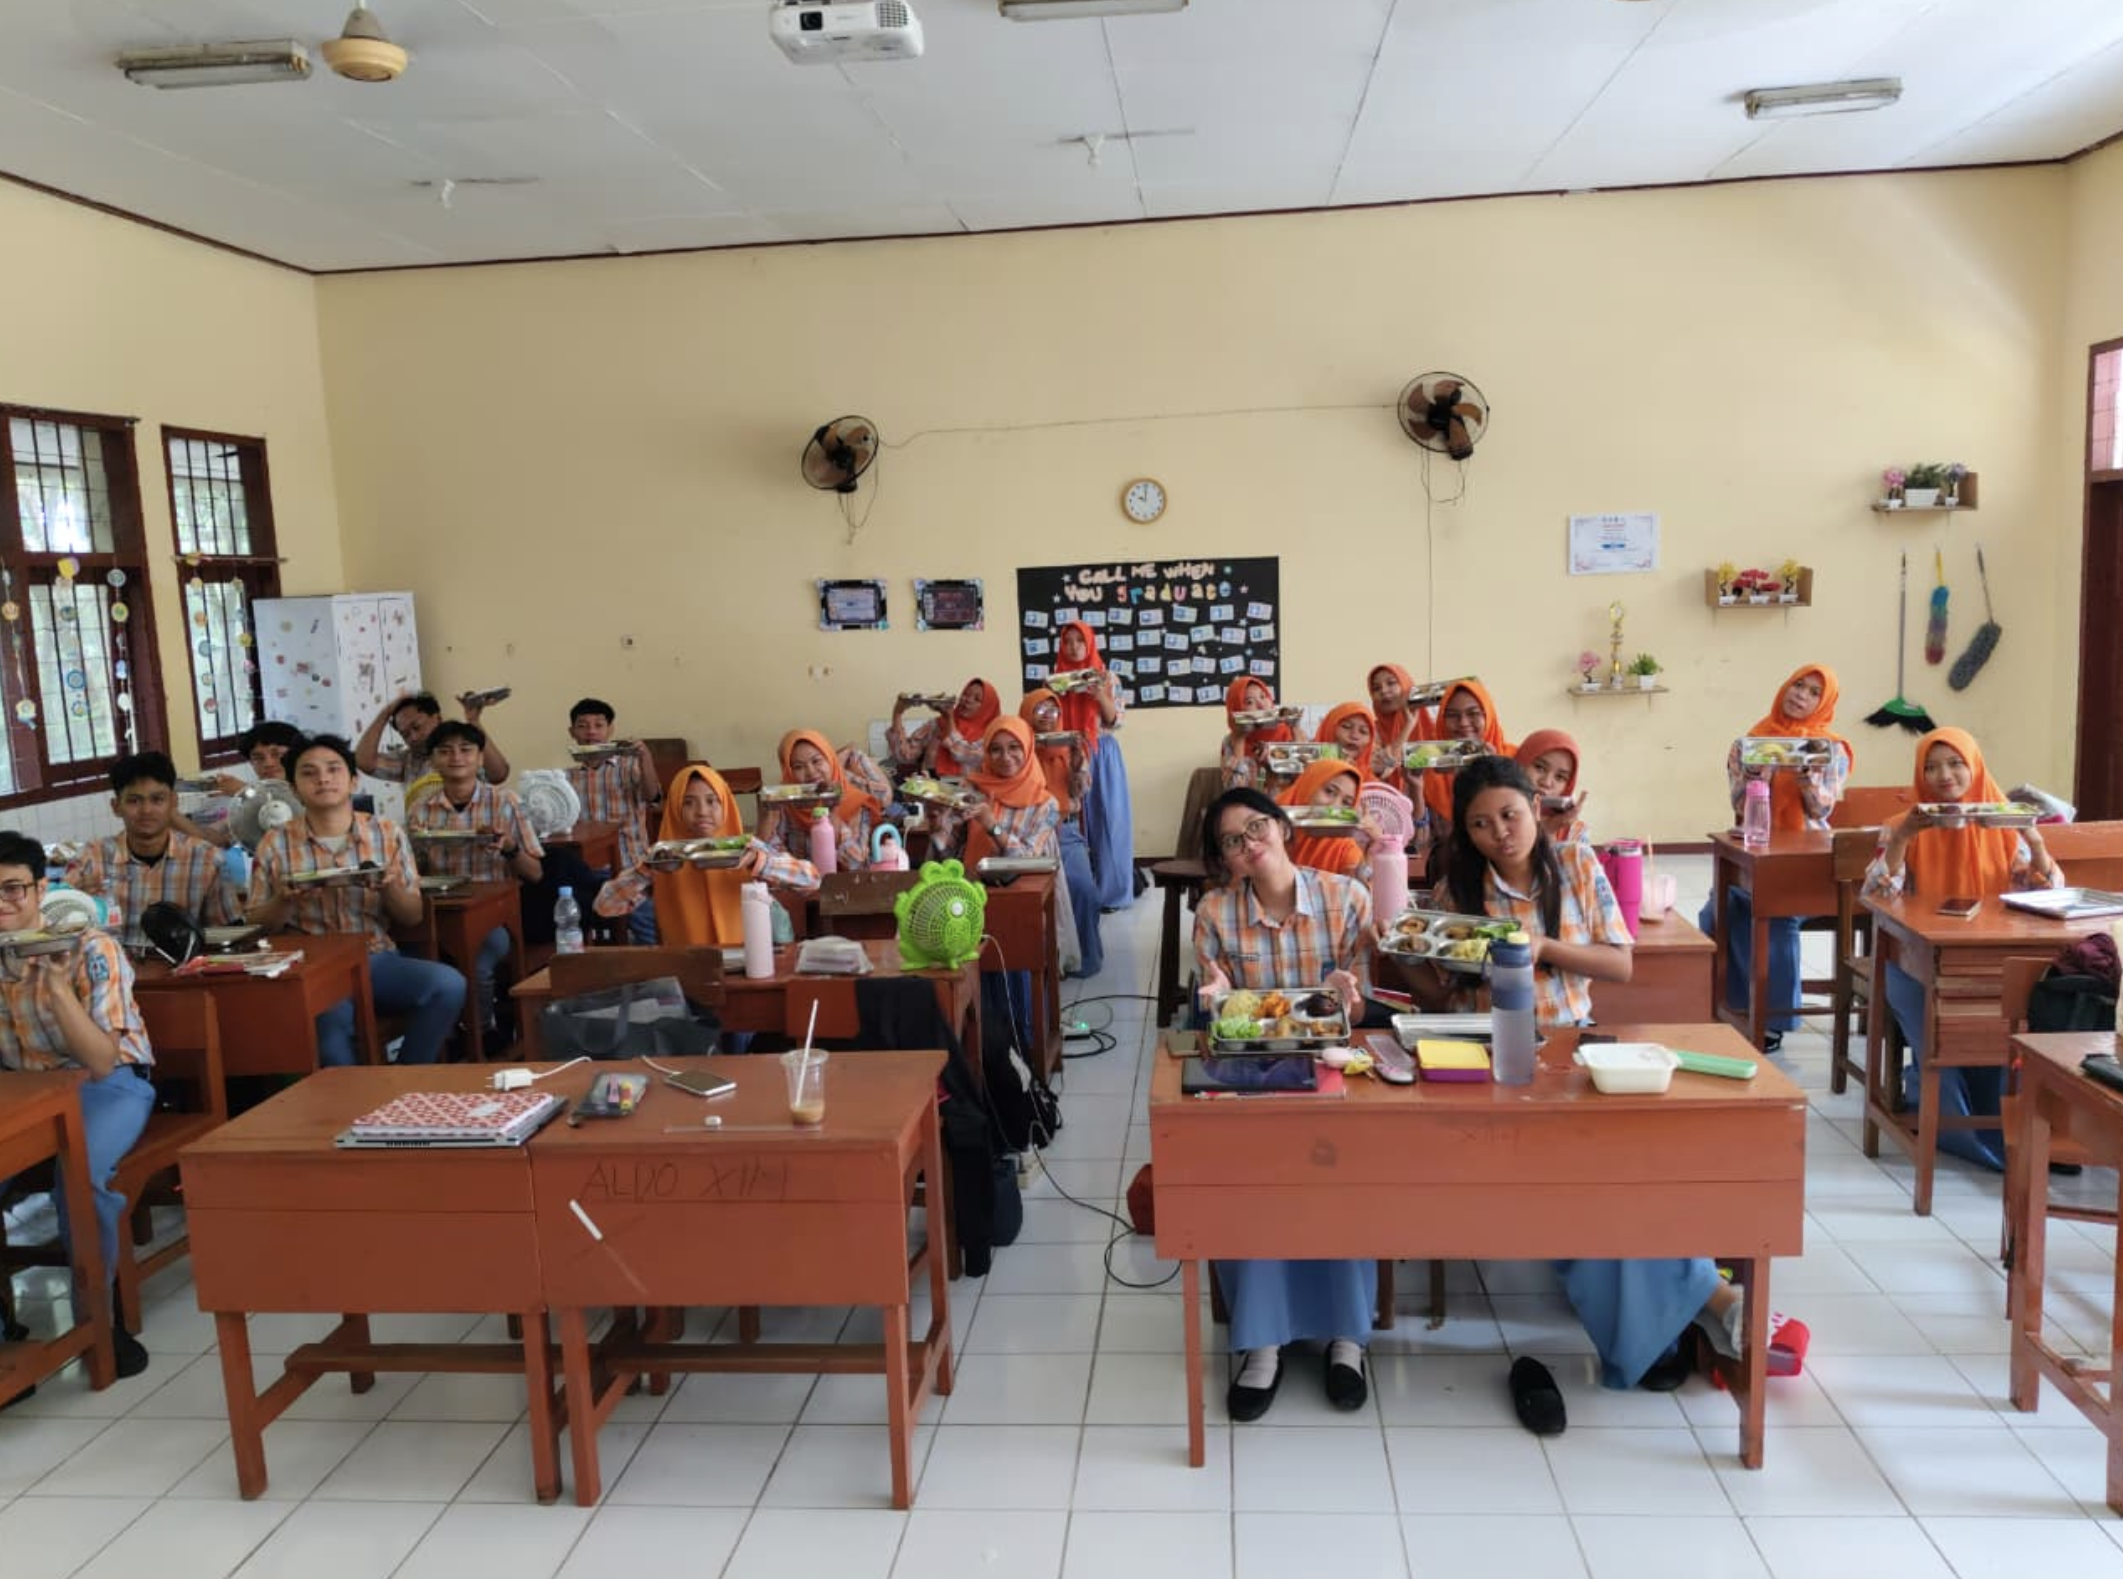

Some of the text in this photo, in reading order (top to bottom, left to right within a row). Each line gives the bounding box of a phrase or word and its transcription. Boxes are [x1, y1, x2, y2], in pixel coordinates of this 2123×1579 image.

[1131, 562, 1158, 579] ME
[1063, 580, 1232, 605] YOU graduate
[578, 1158, 679, 1203] ALDO
